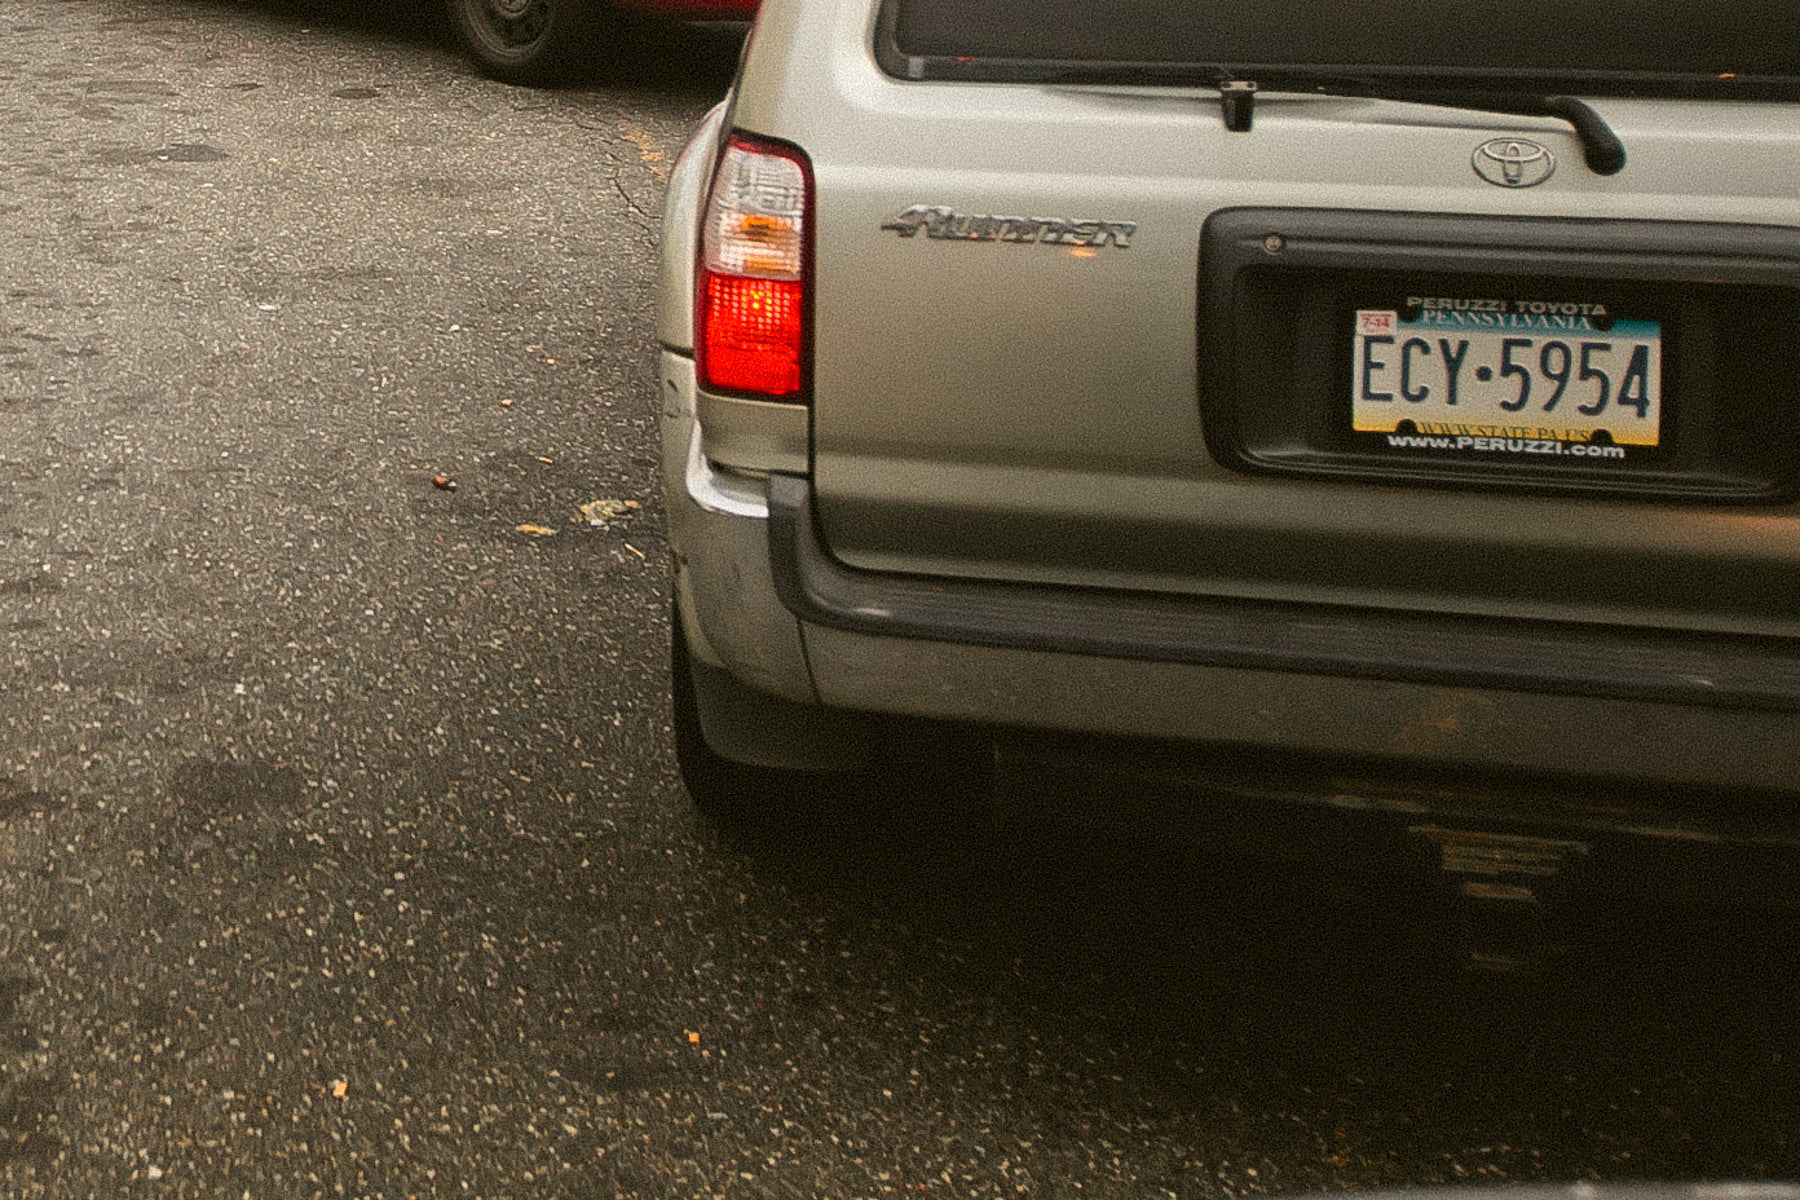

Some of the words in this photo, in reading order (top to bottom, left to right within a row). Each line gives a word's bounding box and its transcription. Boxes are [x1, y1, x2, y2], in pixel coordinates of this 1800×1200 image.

[1407, 297, 1507, 311] PERUZZI
[1514, 301, 1608, 315] TOYOTA
[1423, 309, 1591, 330] PENNSYLVANIA
[1387, 434, 1626, 459] www.PERUZZI.com
